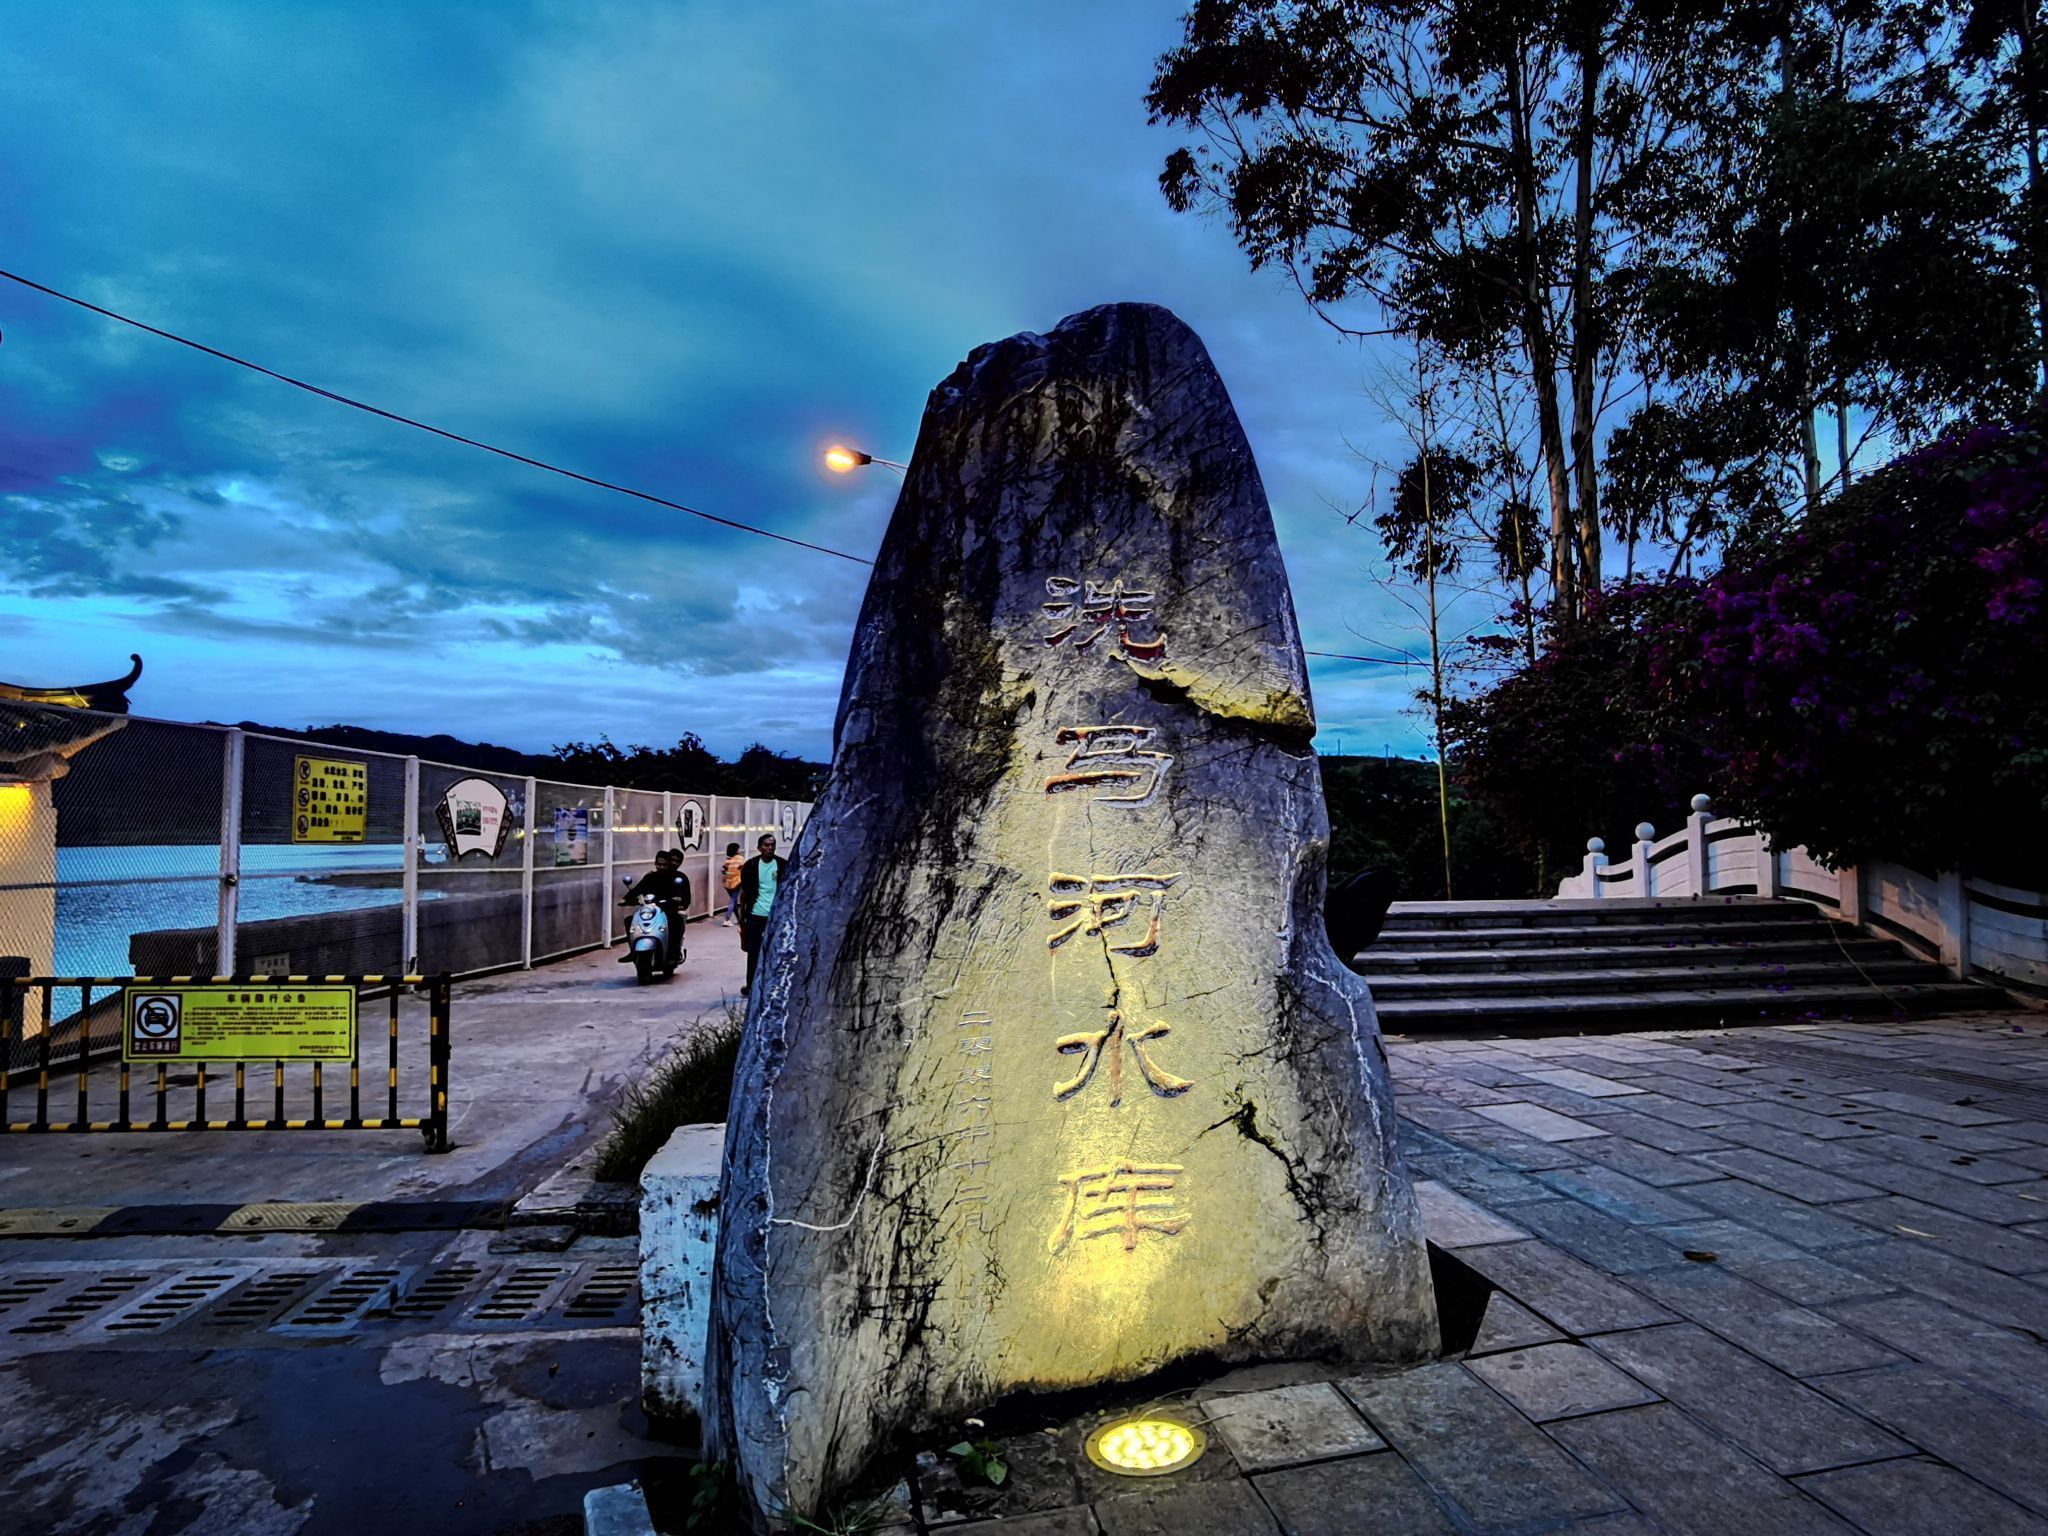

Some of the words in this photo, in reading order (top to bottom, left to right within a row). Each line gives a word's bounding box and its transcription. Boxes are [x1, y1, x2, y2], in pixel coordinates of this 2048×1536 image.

[1042, 576, 1195, 1255] 洗马河水库
